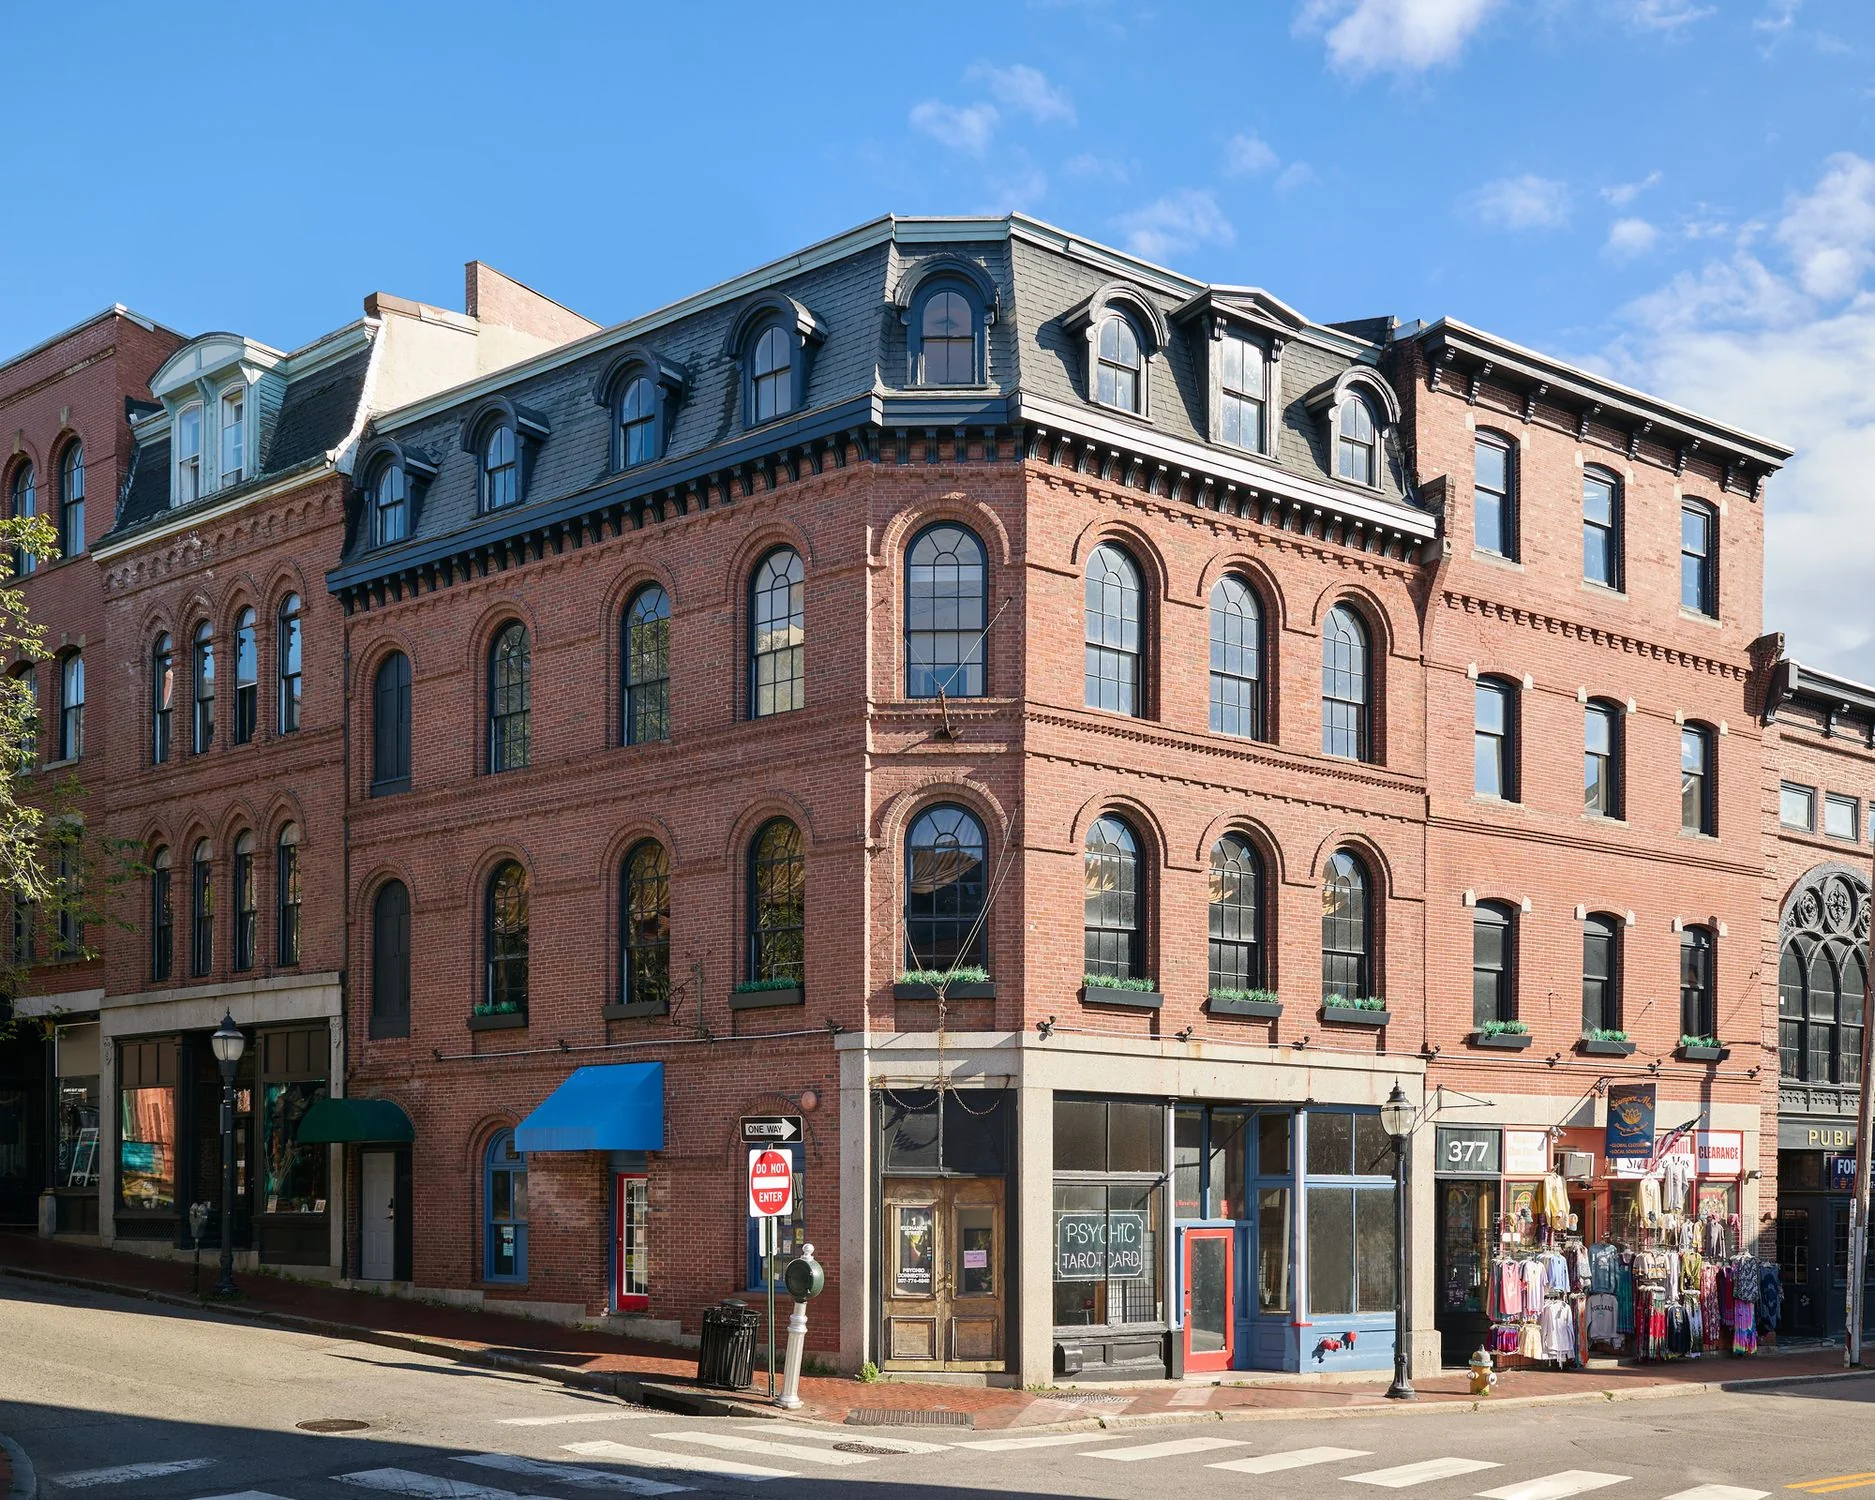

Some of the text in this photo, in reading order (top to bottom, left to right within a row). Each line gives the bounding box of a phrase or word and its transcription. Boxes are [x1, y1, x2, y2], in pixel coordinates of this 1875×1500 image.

[748, 1125, 782, 1134] ONE WAY
[1808, 1129, 1855, 1146] PUBL
[1448, 1140, 1489, 1162] 377
[1699, 1146, 1739, 1159] CLEARANCE
[756, 1163, 785, 1174] DO NOT
[1837, 1159, 1856, 1174] FOR
[759, 1191, 783, 1202] ENTER
[911, 1217, 916, 1225] 1
[1066, 1223, 1135, 1244] PSYCHIC
[1062, 1251, 1139, 1268] TAROT CARD
